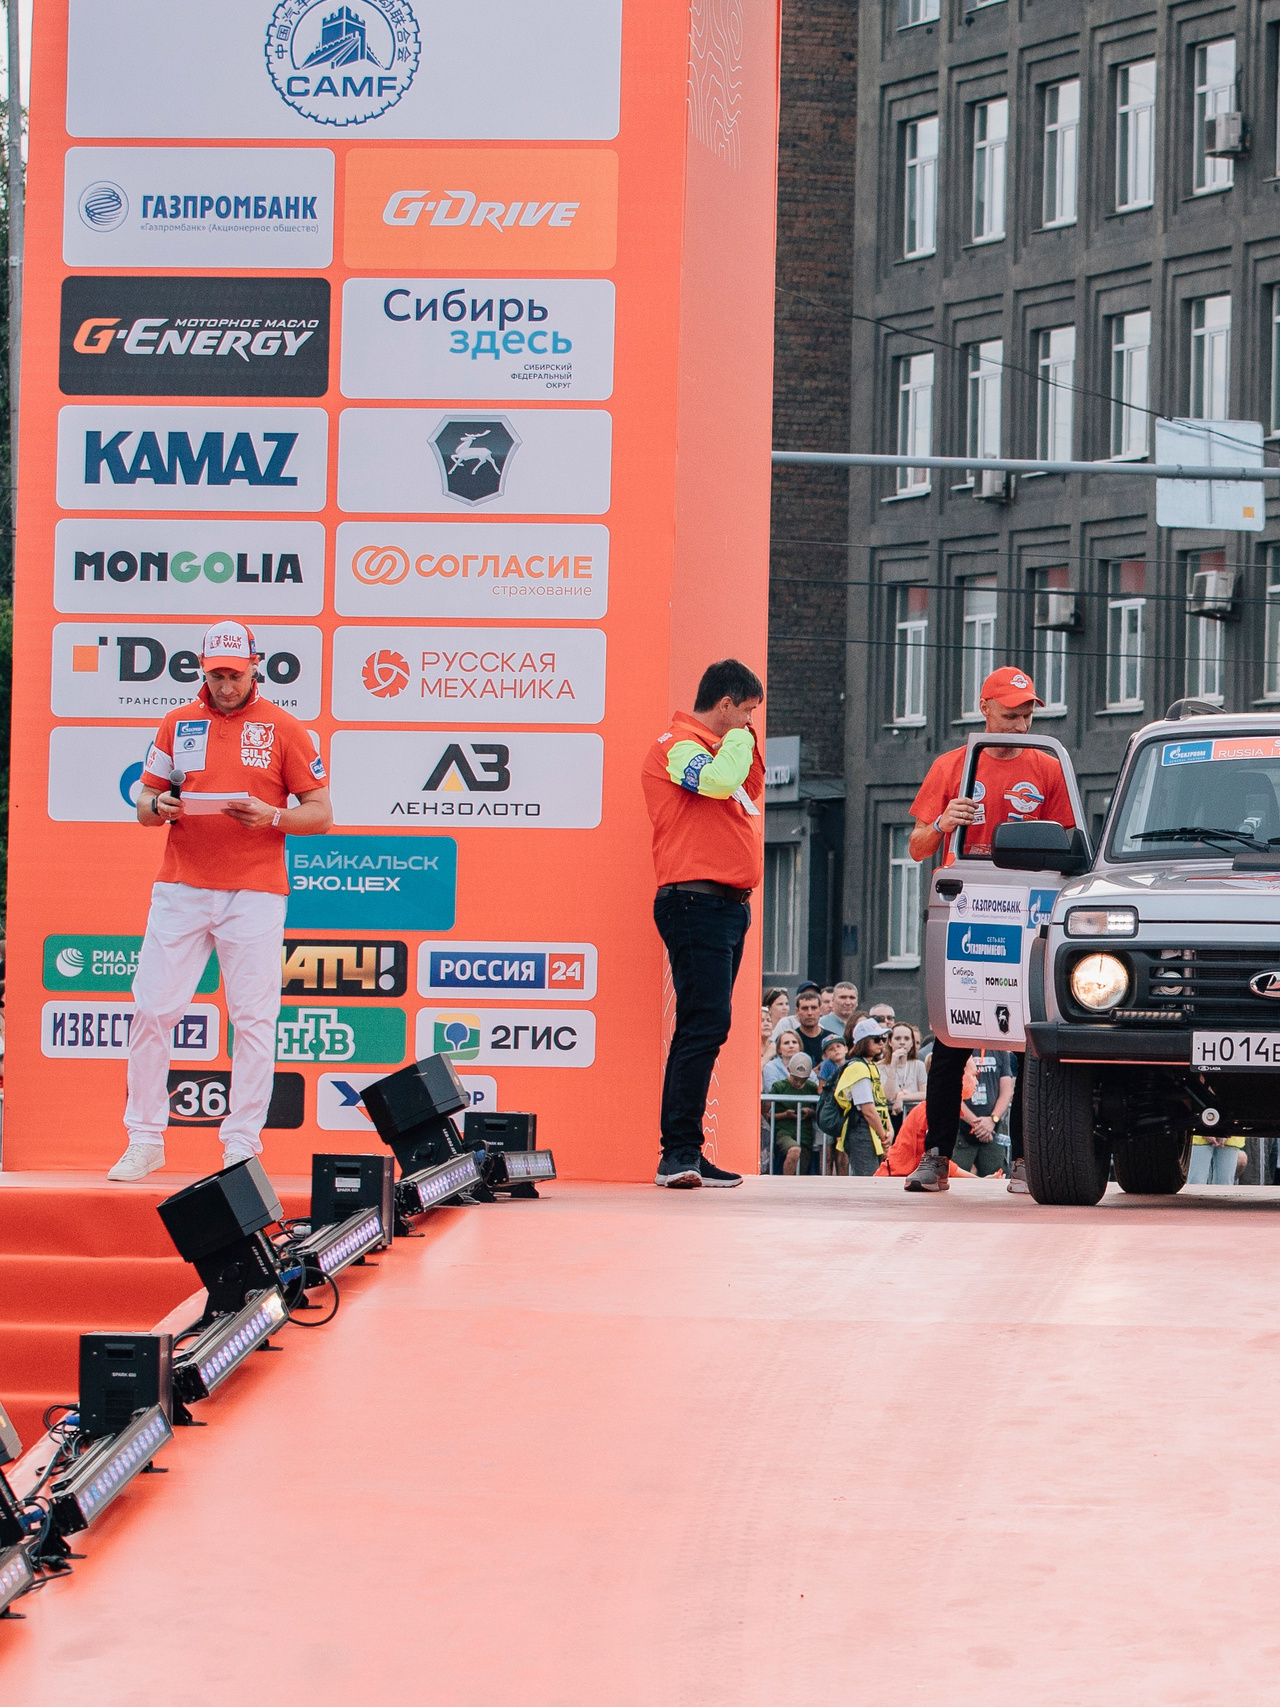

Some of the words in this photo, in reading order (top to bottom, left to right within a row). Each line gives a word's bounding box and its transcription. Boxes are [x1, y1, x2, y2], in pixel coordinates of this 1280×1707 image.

[287, 76, 397, 97] CAMF
[142, 195, 317, 219] ГАЗПРОМБАНК
[209, 224, 270, 233] (Акционерное
[273, 225, 319, 233] общество)
[384, 288, 548, 330] Сибирь
[175, 319, 262, 327] МОТОРНОЕ
[265, 320, 319, 328] МАСЛО
[450, 330, 573, 360] здесь
[85, 431, 299, 486] KAMAZ
[74, 551, 303, 583] MONGOLIA
[415, 554, 592, 579] СОГЛАСИЕ
[492, 585, 592, 597] страхование
[117, 637, 301, 684] Deo
[421, 651, 556, 672] РУССКАЯ
[421, 678, 575, 699] МЕХАНИКА
[119, 697, 197, 705] ТРАНСПОРТ
[241, 749, 271, 760] SILK
[1218, 748, 1264, 758] RUSSIA
[241, 758, 271, 769] WAY
[391, 802, 540, 816] ЛЕНЗОЛОТО
[294, 851, 439, 870] БАЙКАЛЬСК
[293, 876, 400, 893] ЭКО.ЦЕХ
[972, 899, 1021, 913] ГАЗПРОМБАНК
[92, 950, 126, 962] РИА
[439, 960, 535, 981] РОССИЯ
[551, 961, 581, 981] 24
[952, 967, 974, 976] Сибирь
[985, 977, 1018, 987] MONGOLIA
[951, 1009, 982, 1025] KAMAZ
[491, 1025, 577, 1050] 2ГИС
[175, 1081, 231, 1116] 36
